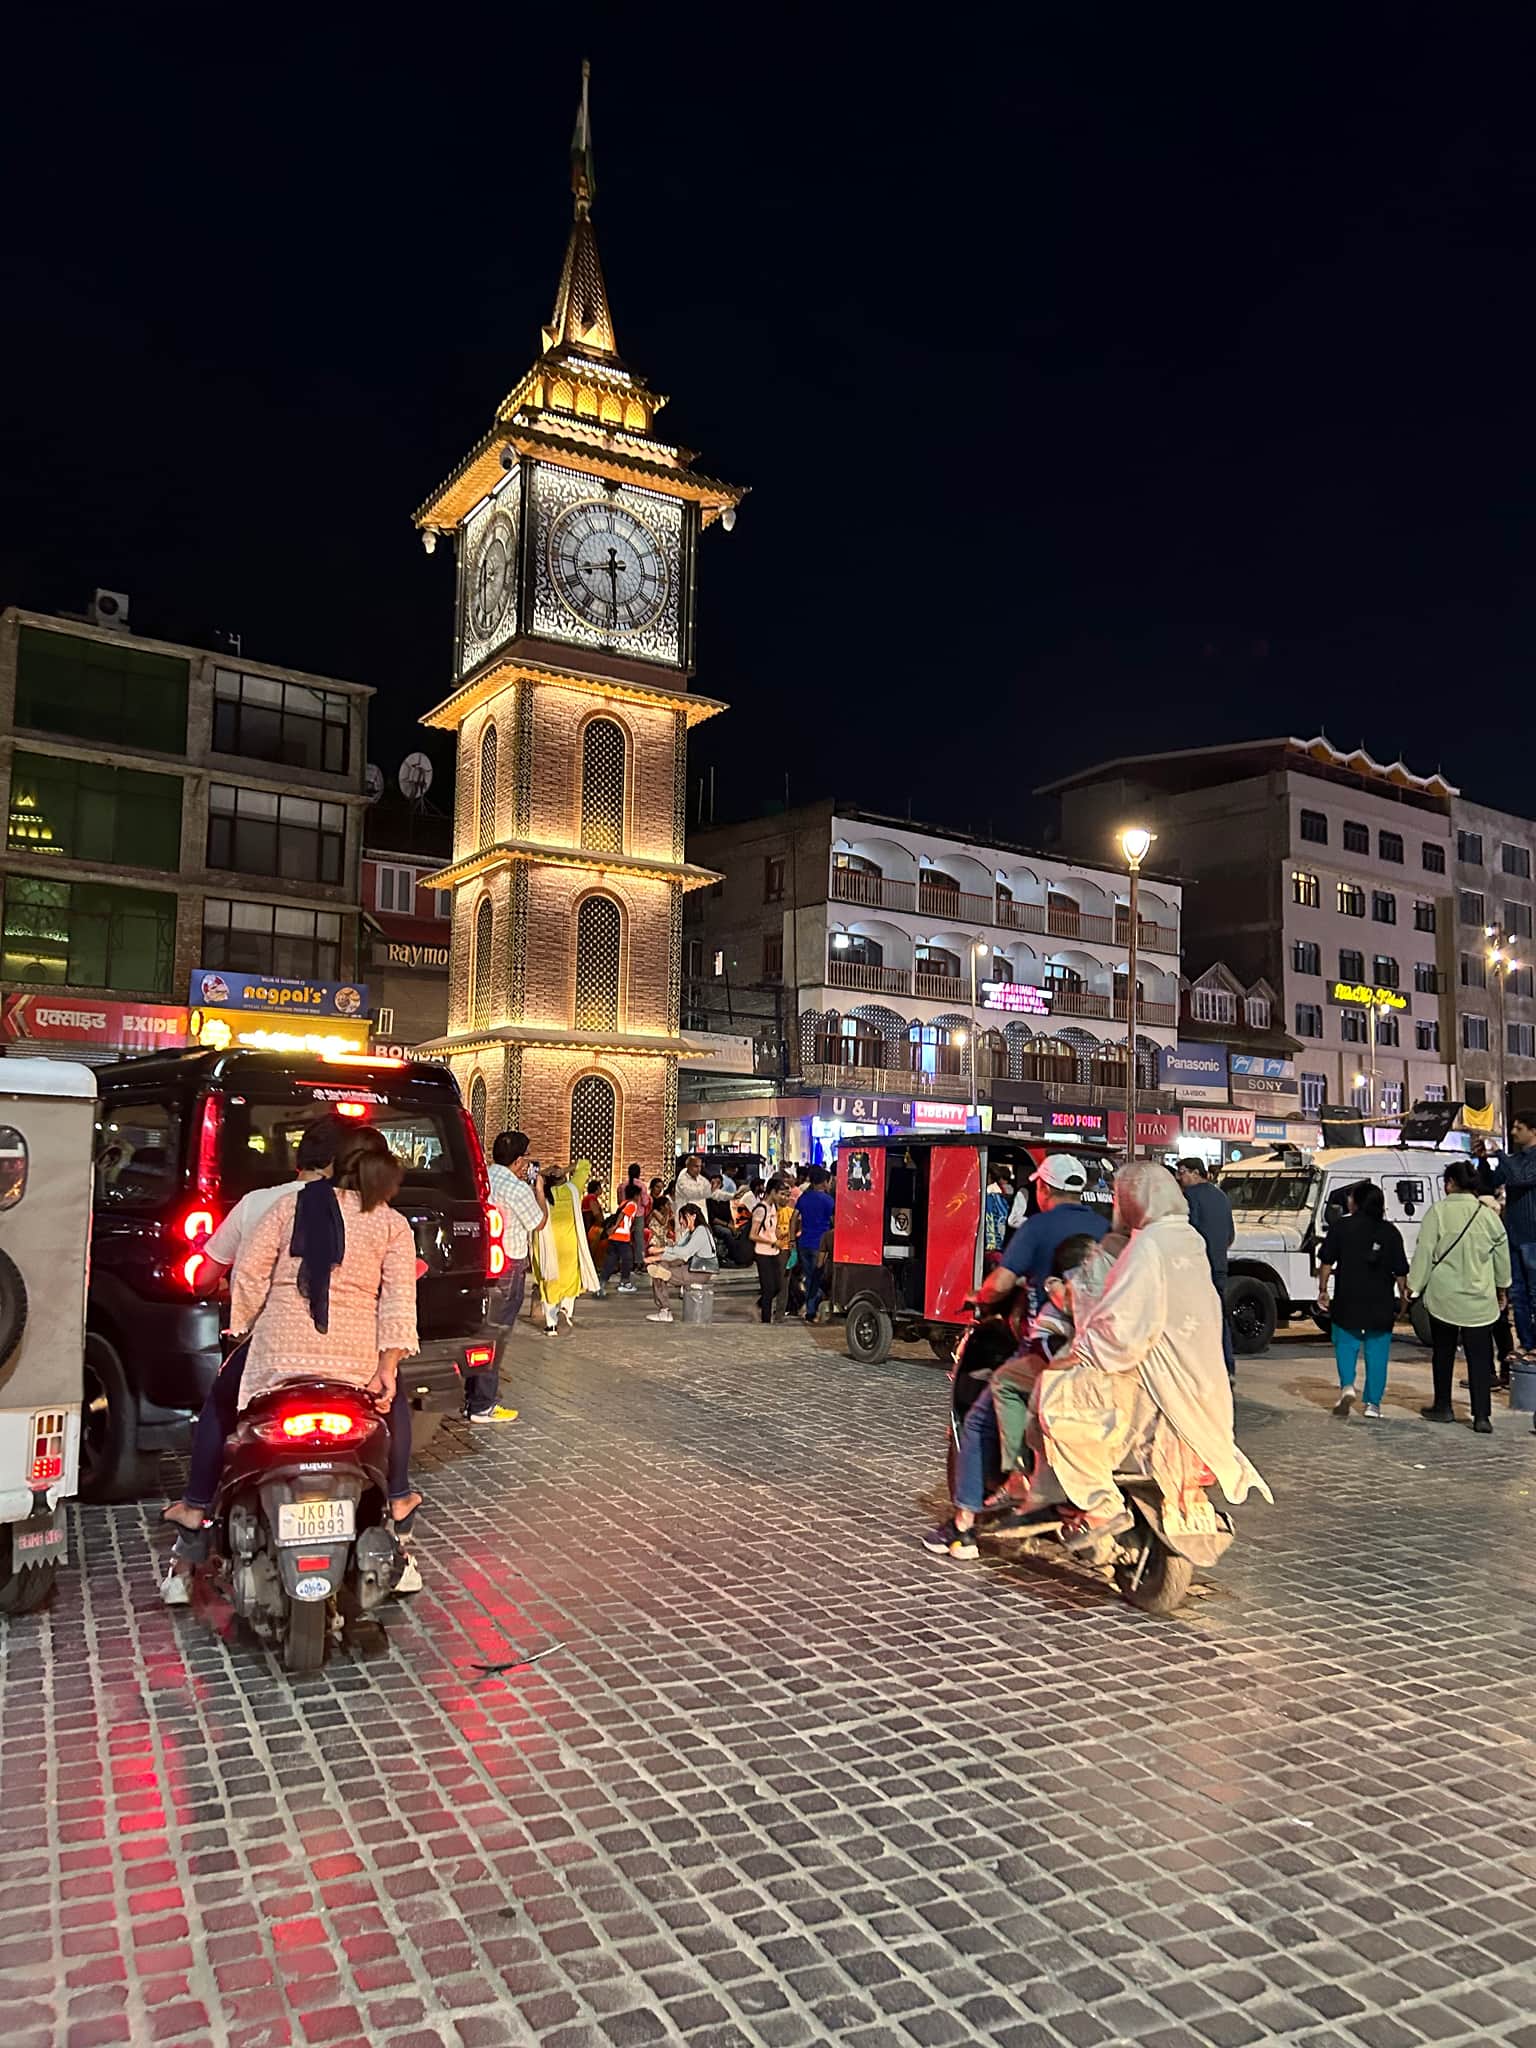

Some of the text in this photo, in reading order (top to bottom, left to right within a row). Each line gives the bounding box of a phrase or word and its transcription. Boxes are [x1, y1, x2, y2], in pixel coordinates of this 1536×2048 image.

[387, 943, 451, 968] Raymo
[243, 985, 322, 1005] nagpal's
[36, 1008, 107, 1030] एक्साइड
[122, 1015, 178, 1034] EXIDE
[375, 1045, 448, 1063] BOMA
[1166, 1055, 1220, 1072] Panasonic
[1248, 1079, 1283, 1092] SONY
[833, 1097, 878, 1118] U & I
[917, 1103, 965, 1120] LIBERTY
[1052, 1112, 1075, 1127] ZERO
[1076, 1114, 1102, 1128] POINT
[1137, 1122, 1167, 1136] TITAN
[1187, 1115, 1252, 1135] RIGHTWAY
[298, 1503, 344, 1521] JK01A
[297, 1518, 344, 1536] U0993
